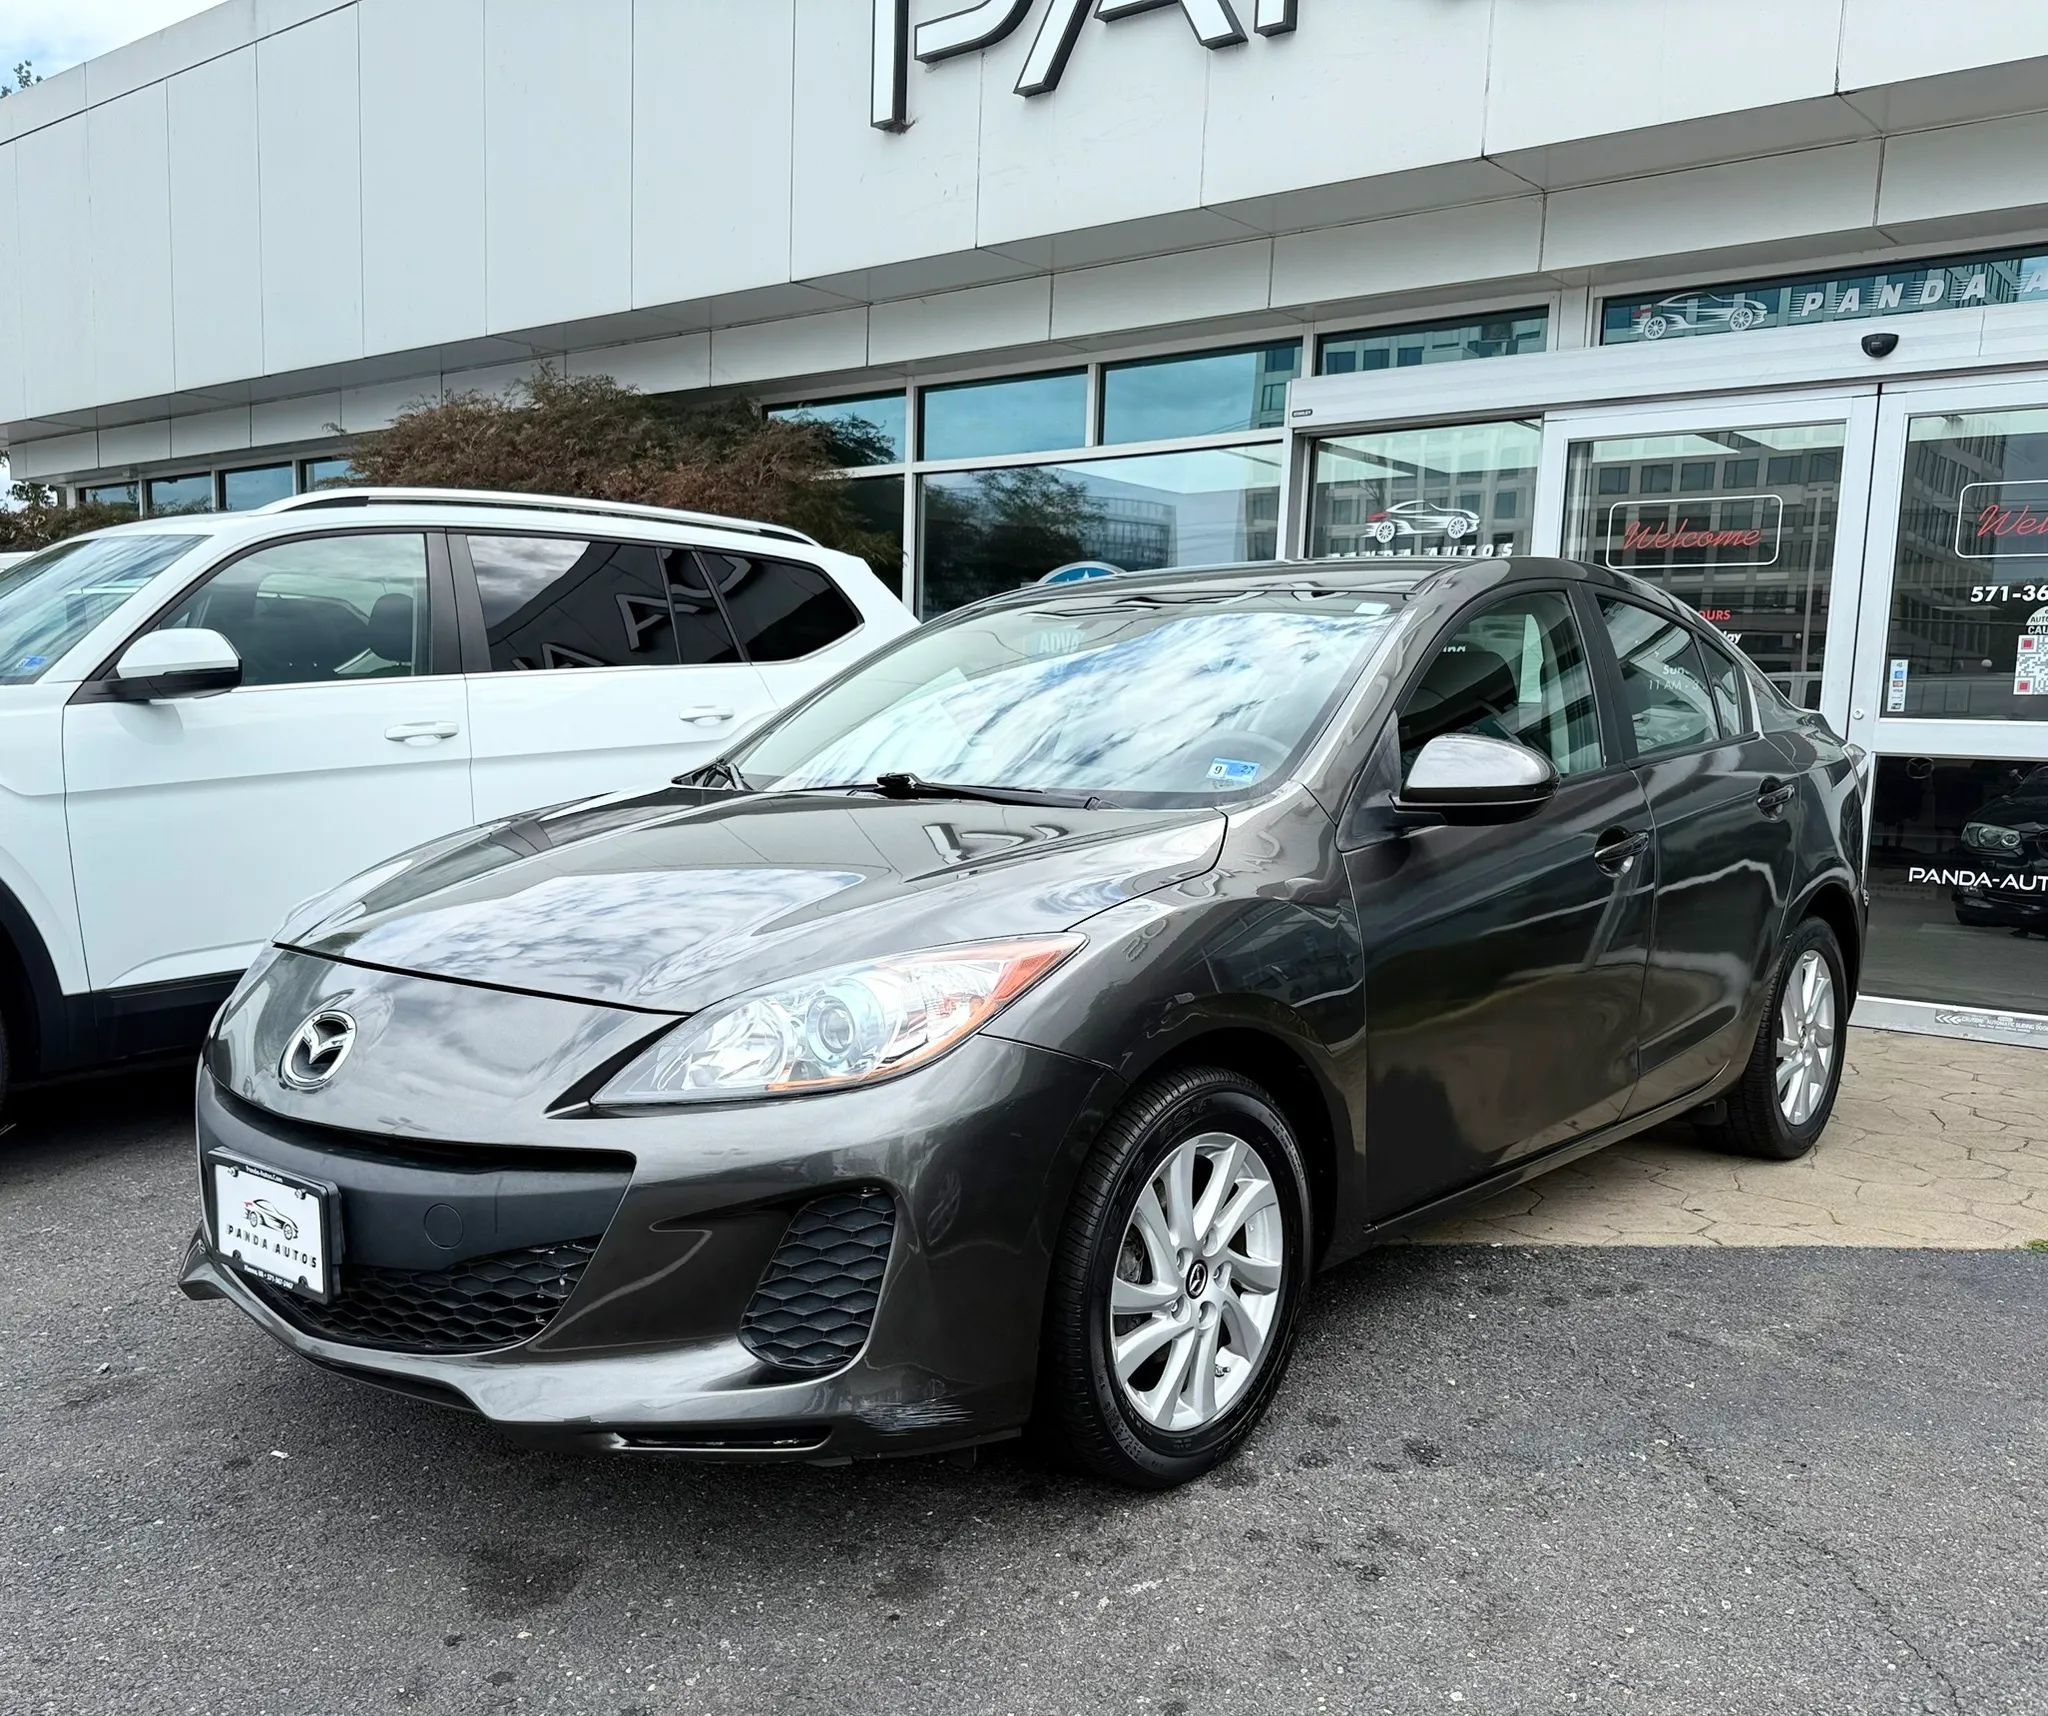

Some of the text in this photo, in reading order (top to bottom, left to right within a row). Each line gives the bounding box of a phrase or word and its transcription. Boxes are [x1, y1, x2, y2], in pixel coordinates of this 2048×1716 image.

[1794, 272, 1986, 317] PANDA
[1623, 518, 1761, 550] Welcome
[227, 1224, 317, 1268] PANDA AUTOS
